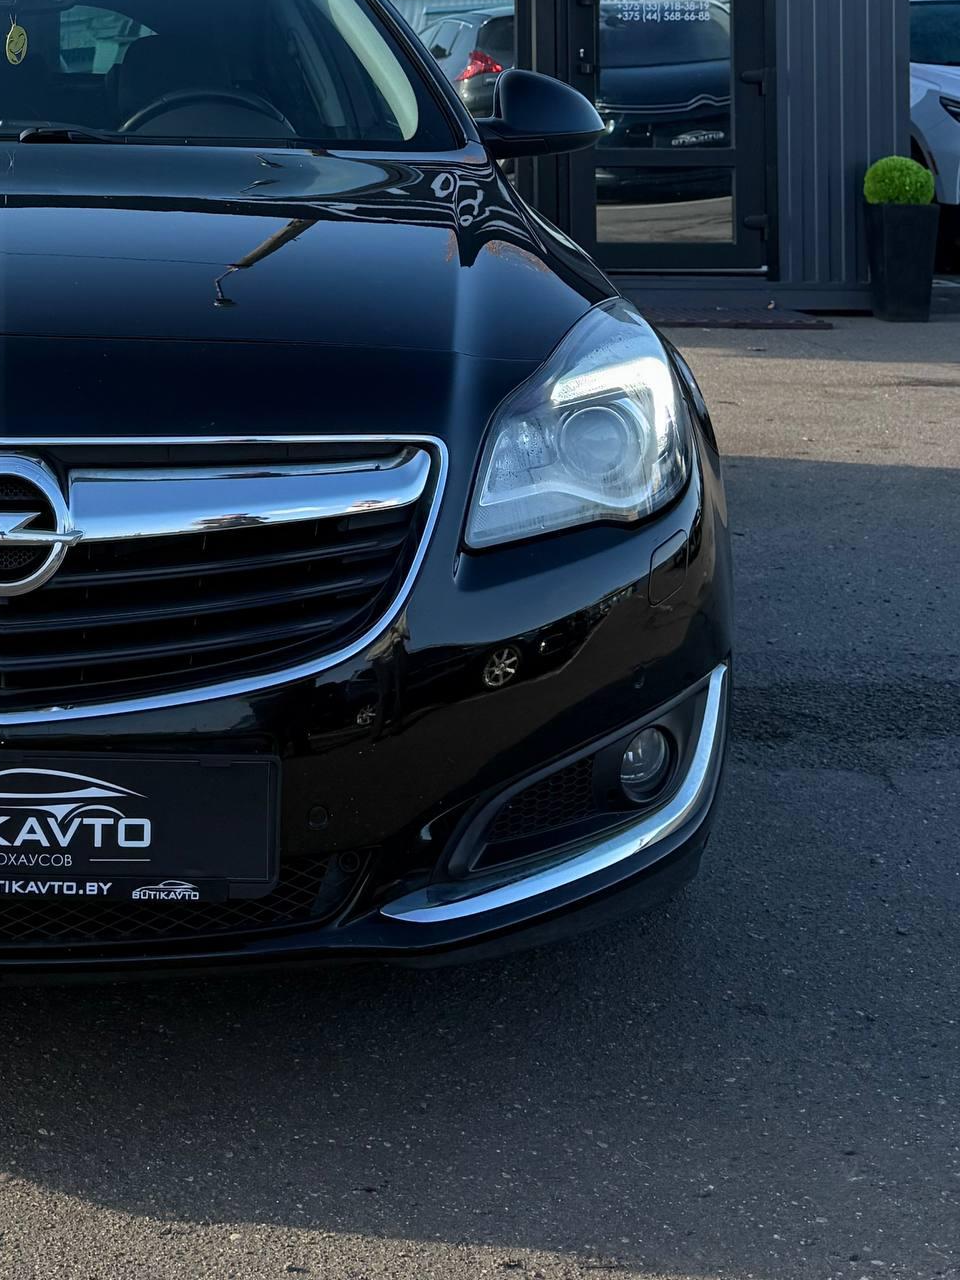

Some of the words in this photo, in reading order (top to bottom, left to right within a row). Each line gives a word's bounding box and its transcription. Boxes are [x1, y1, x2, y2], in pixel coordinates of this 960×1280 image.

[616, 1, 640, 11] +375
[642, 0, 660, 13] (33)
[663, 1, 710, 11] 918-38-19
[616, 11, 640, 21] +375
[642, 10, 660, 23] (44)
[663, 11, 710, 21] 568-66-88
[132, 891, 199, 900] BUTIKAVTO
